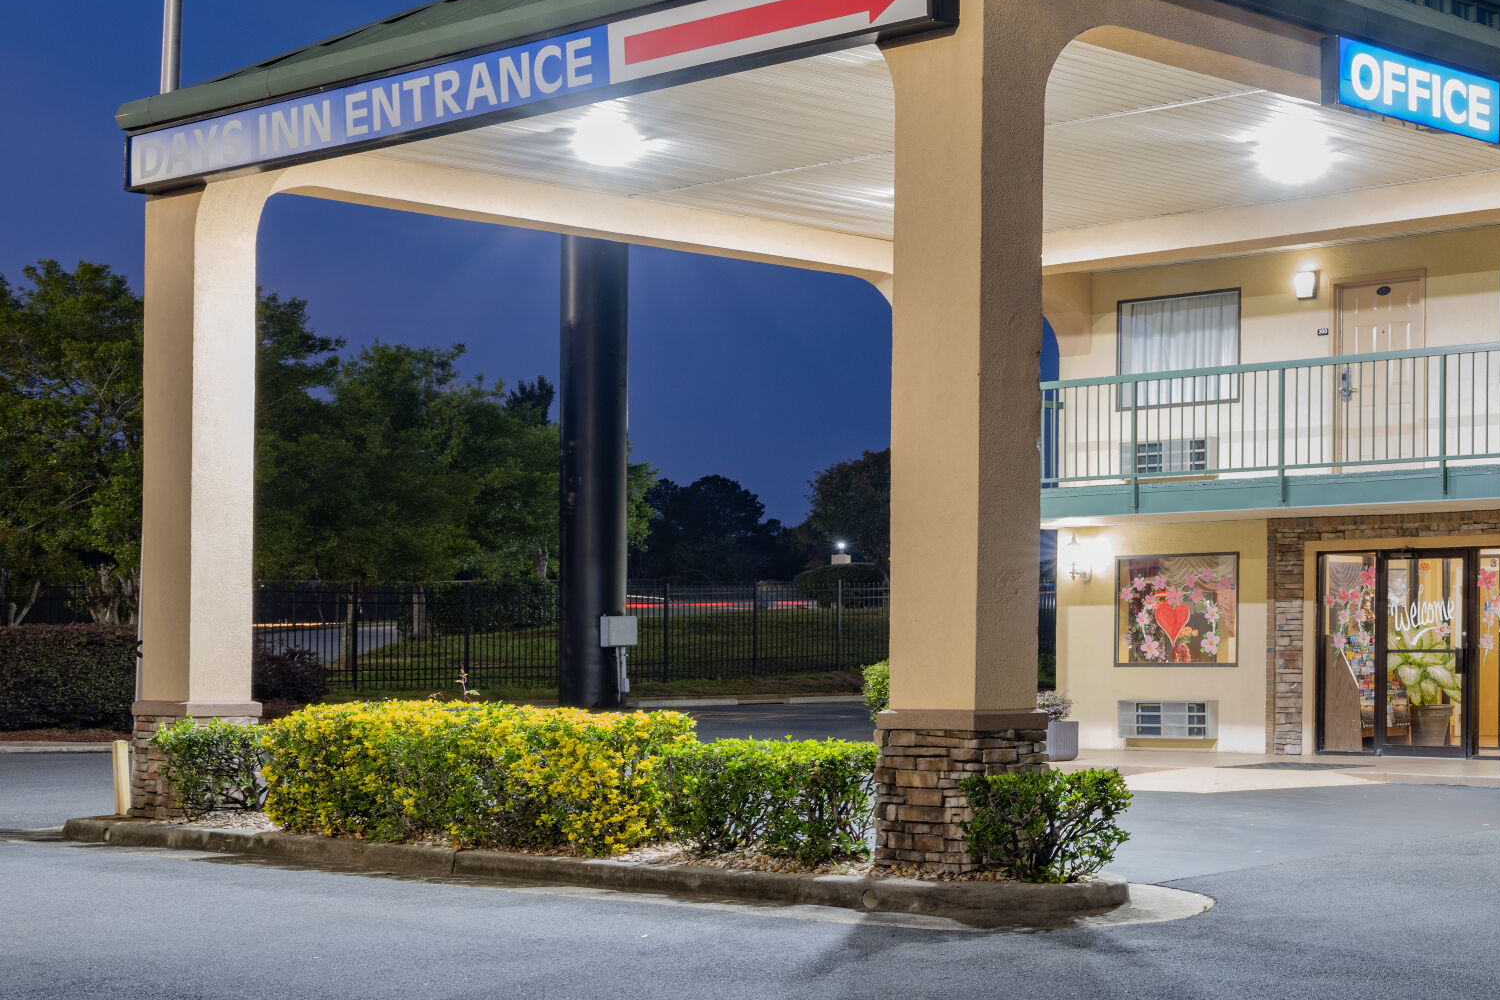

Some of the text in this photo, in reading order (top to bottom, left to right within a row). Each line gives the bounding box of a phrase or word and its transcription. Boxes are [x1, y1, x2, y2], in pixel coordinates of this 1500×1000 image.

[139, 36, 593, 181] DAYS INN ENTRANCE
[1351, 53, 1490, 131] OFFICE
[1391, 584, 1457, 632] Welcome
